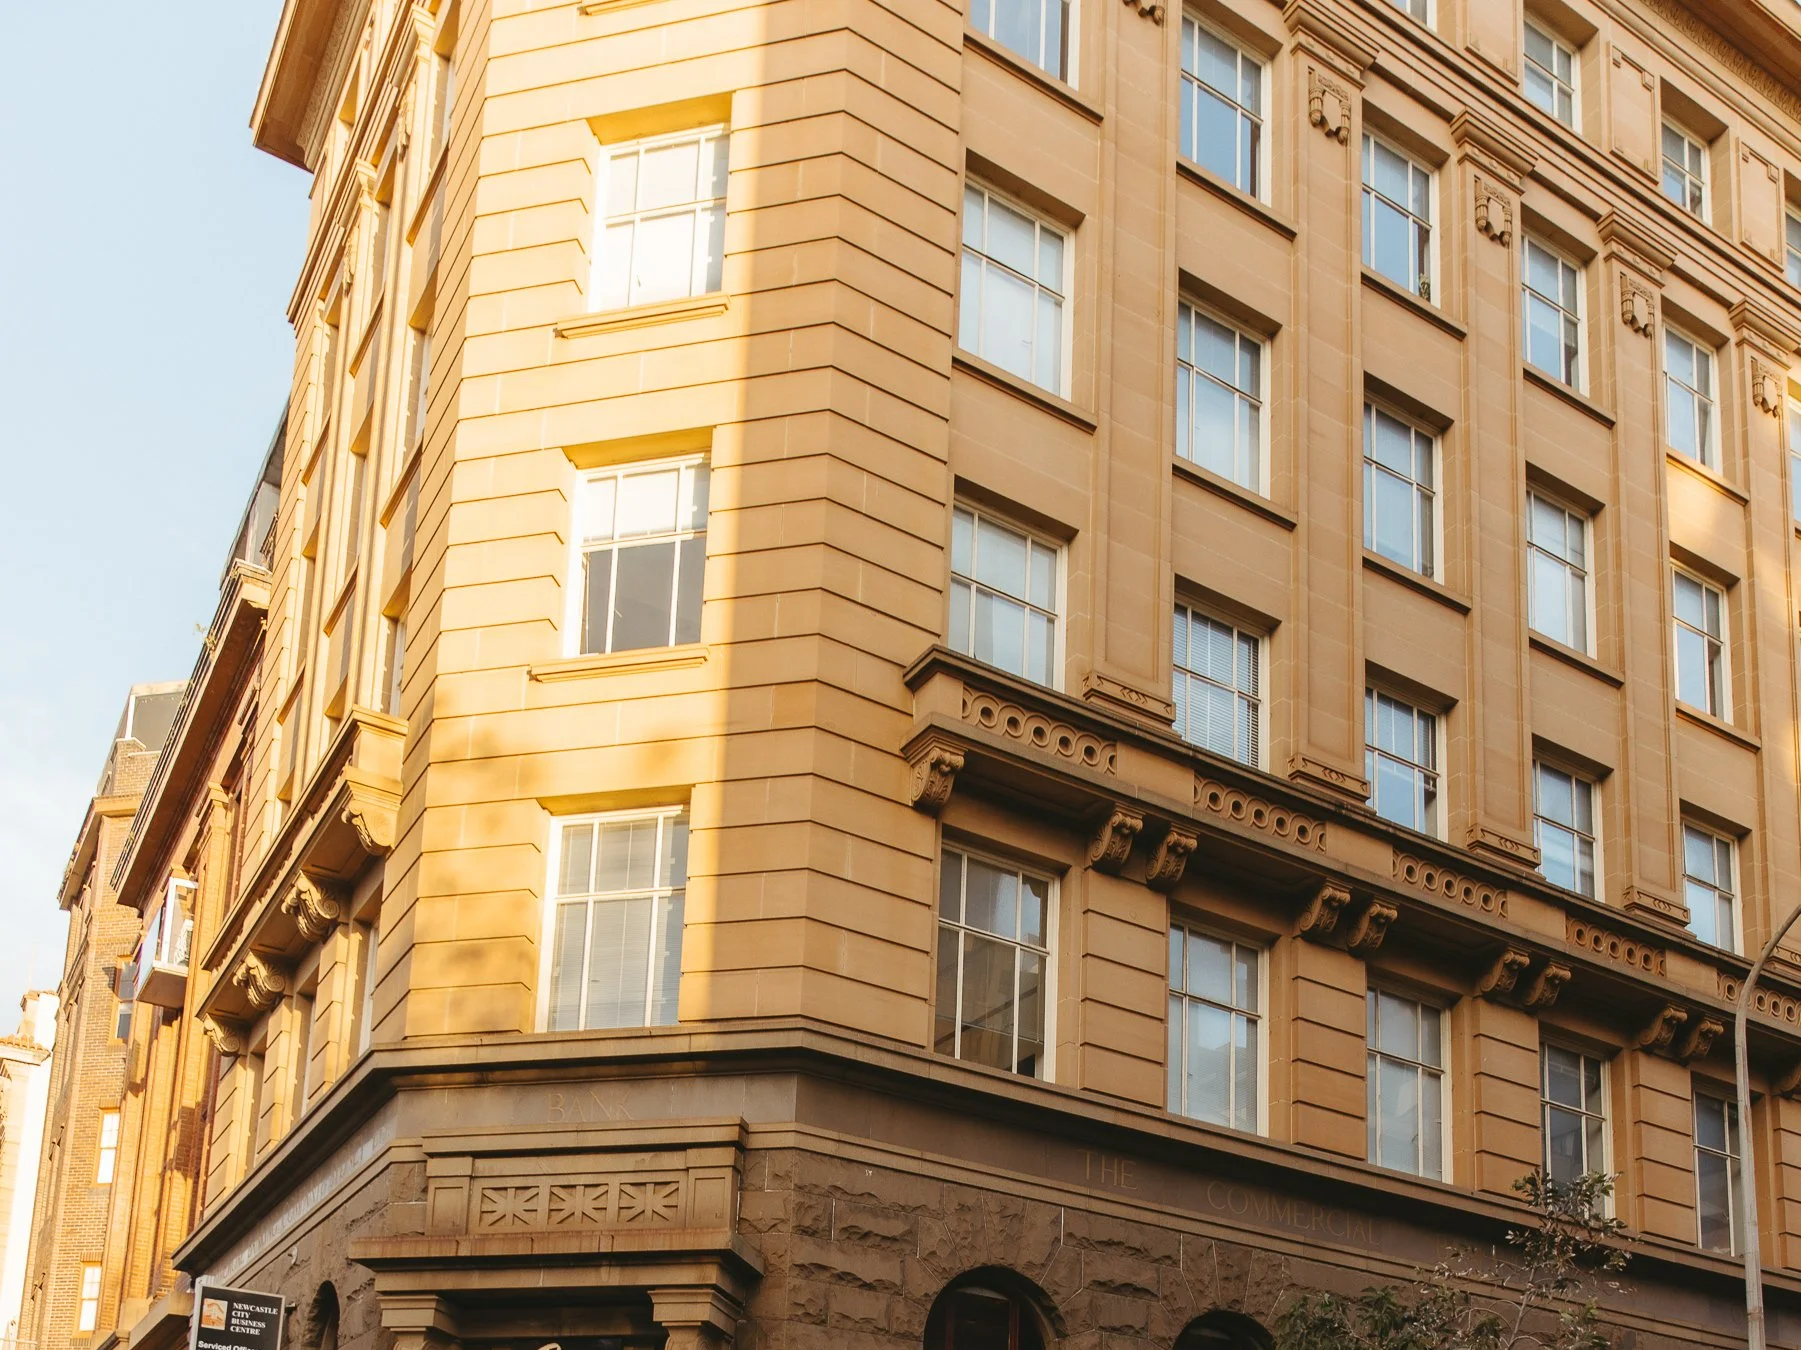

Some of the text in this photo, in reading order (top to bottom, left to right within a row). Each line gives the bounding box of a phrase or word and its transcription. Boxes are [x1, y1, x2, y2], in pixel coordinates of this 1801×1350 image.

[1083, 1150, 1384, 1245] THE COMMERCIAL
[233, 1302, 278, 1315] NEWCASTLE
[231, 1310, 250, 1319] CITY
[231, 1318, 266, 1328] BUSINESS
[230, 1325, 261, 1336] CENTRE
